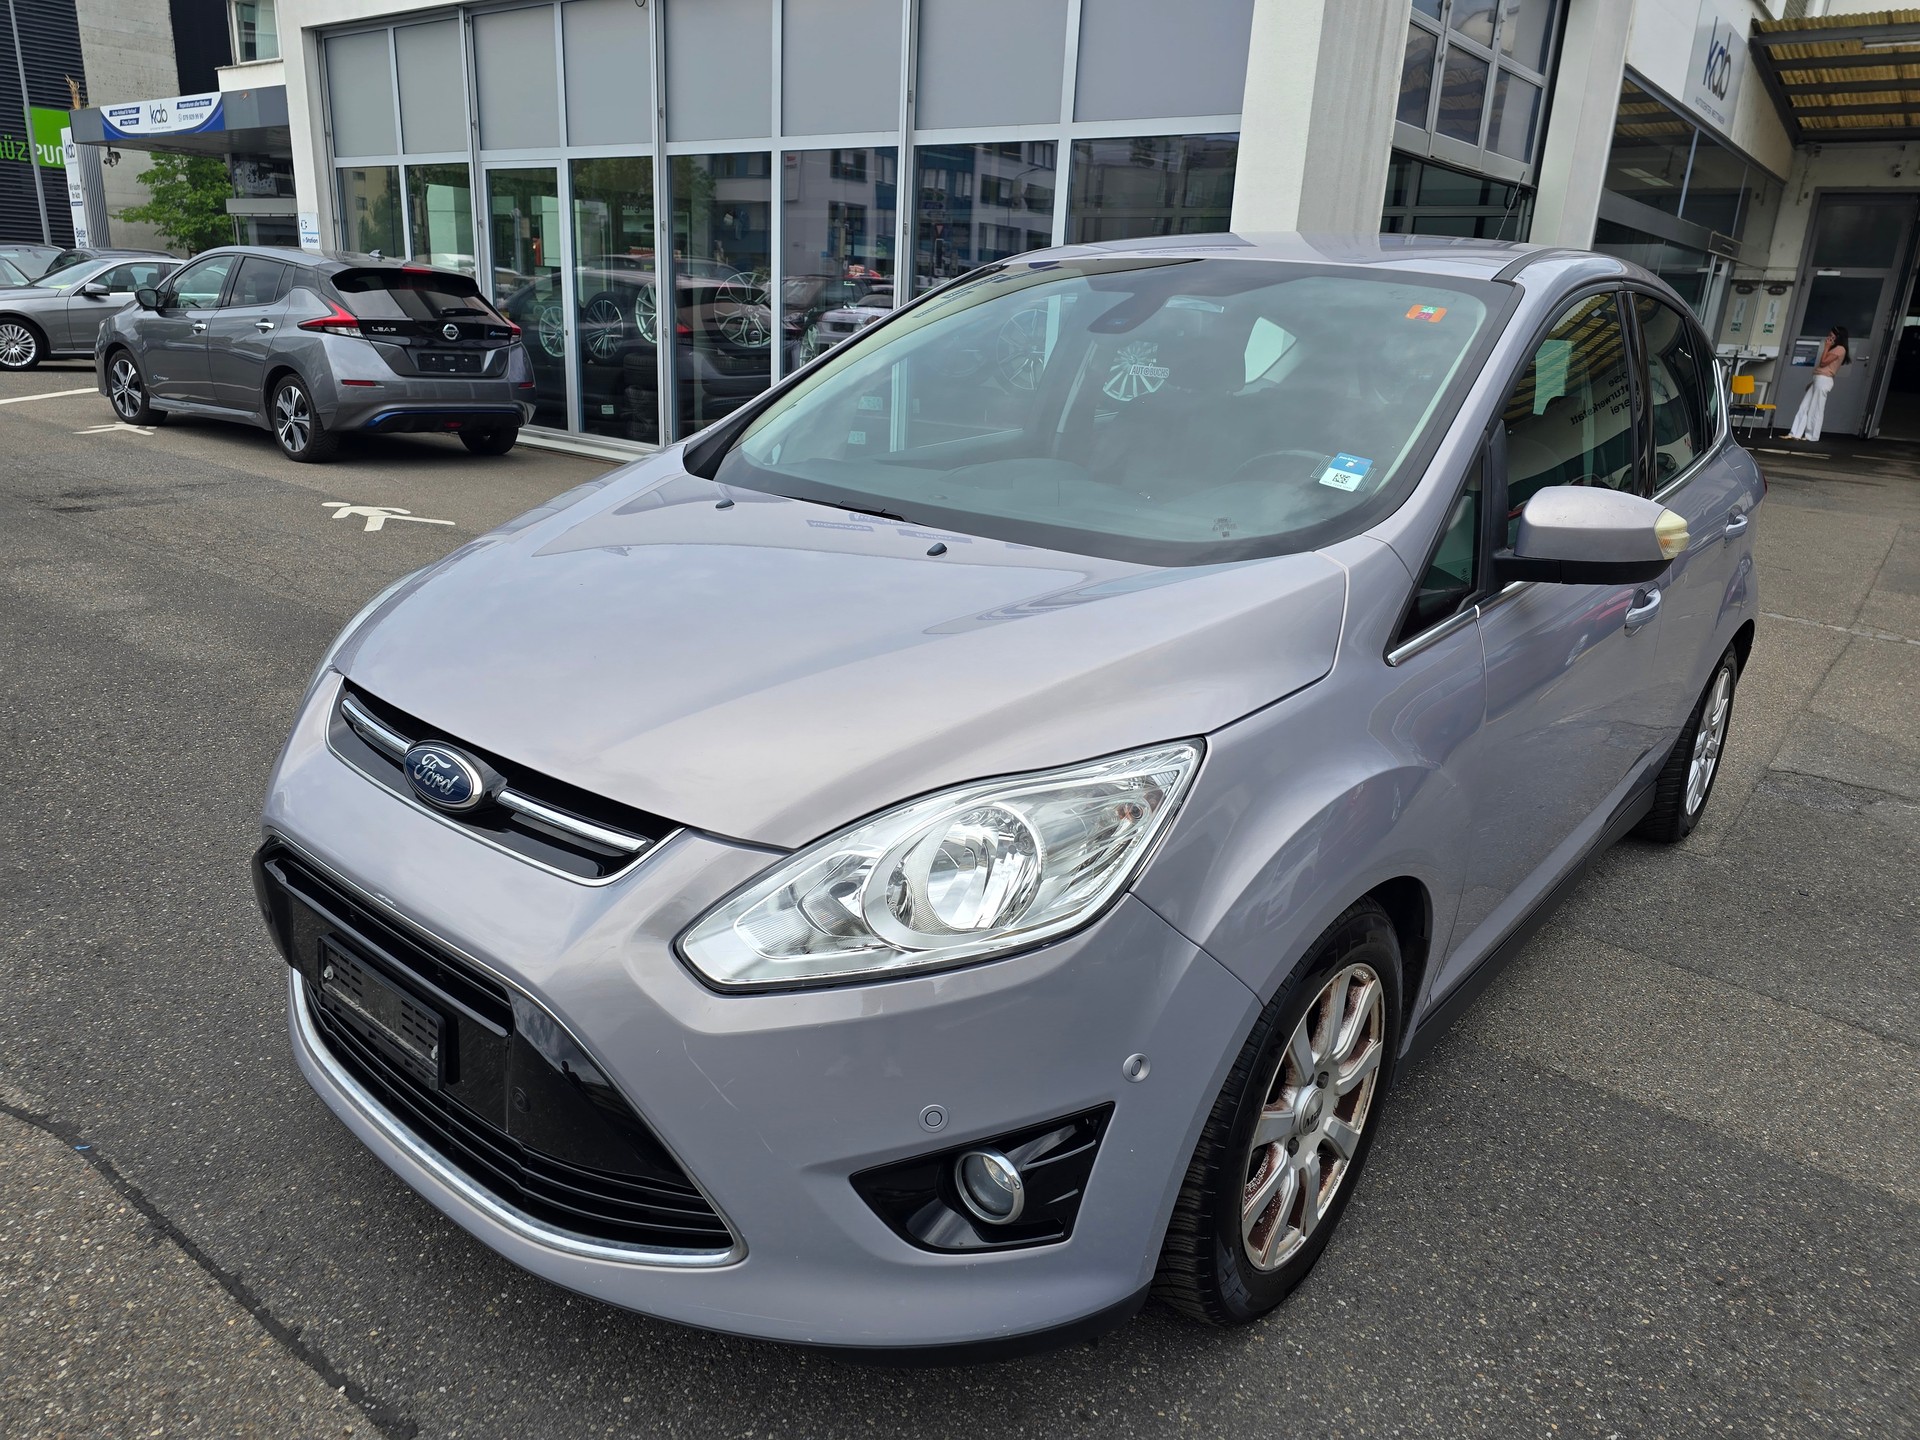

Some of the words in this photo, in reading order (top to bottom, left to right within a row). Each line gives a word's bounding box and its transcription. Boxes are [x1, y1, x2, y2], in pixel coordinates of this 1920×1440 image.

[1703, 16, 1731, 101] kab
[149, 103, 168, 125] kab
[413, 753, 460, 796] Ford
